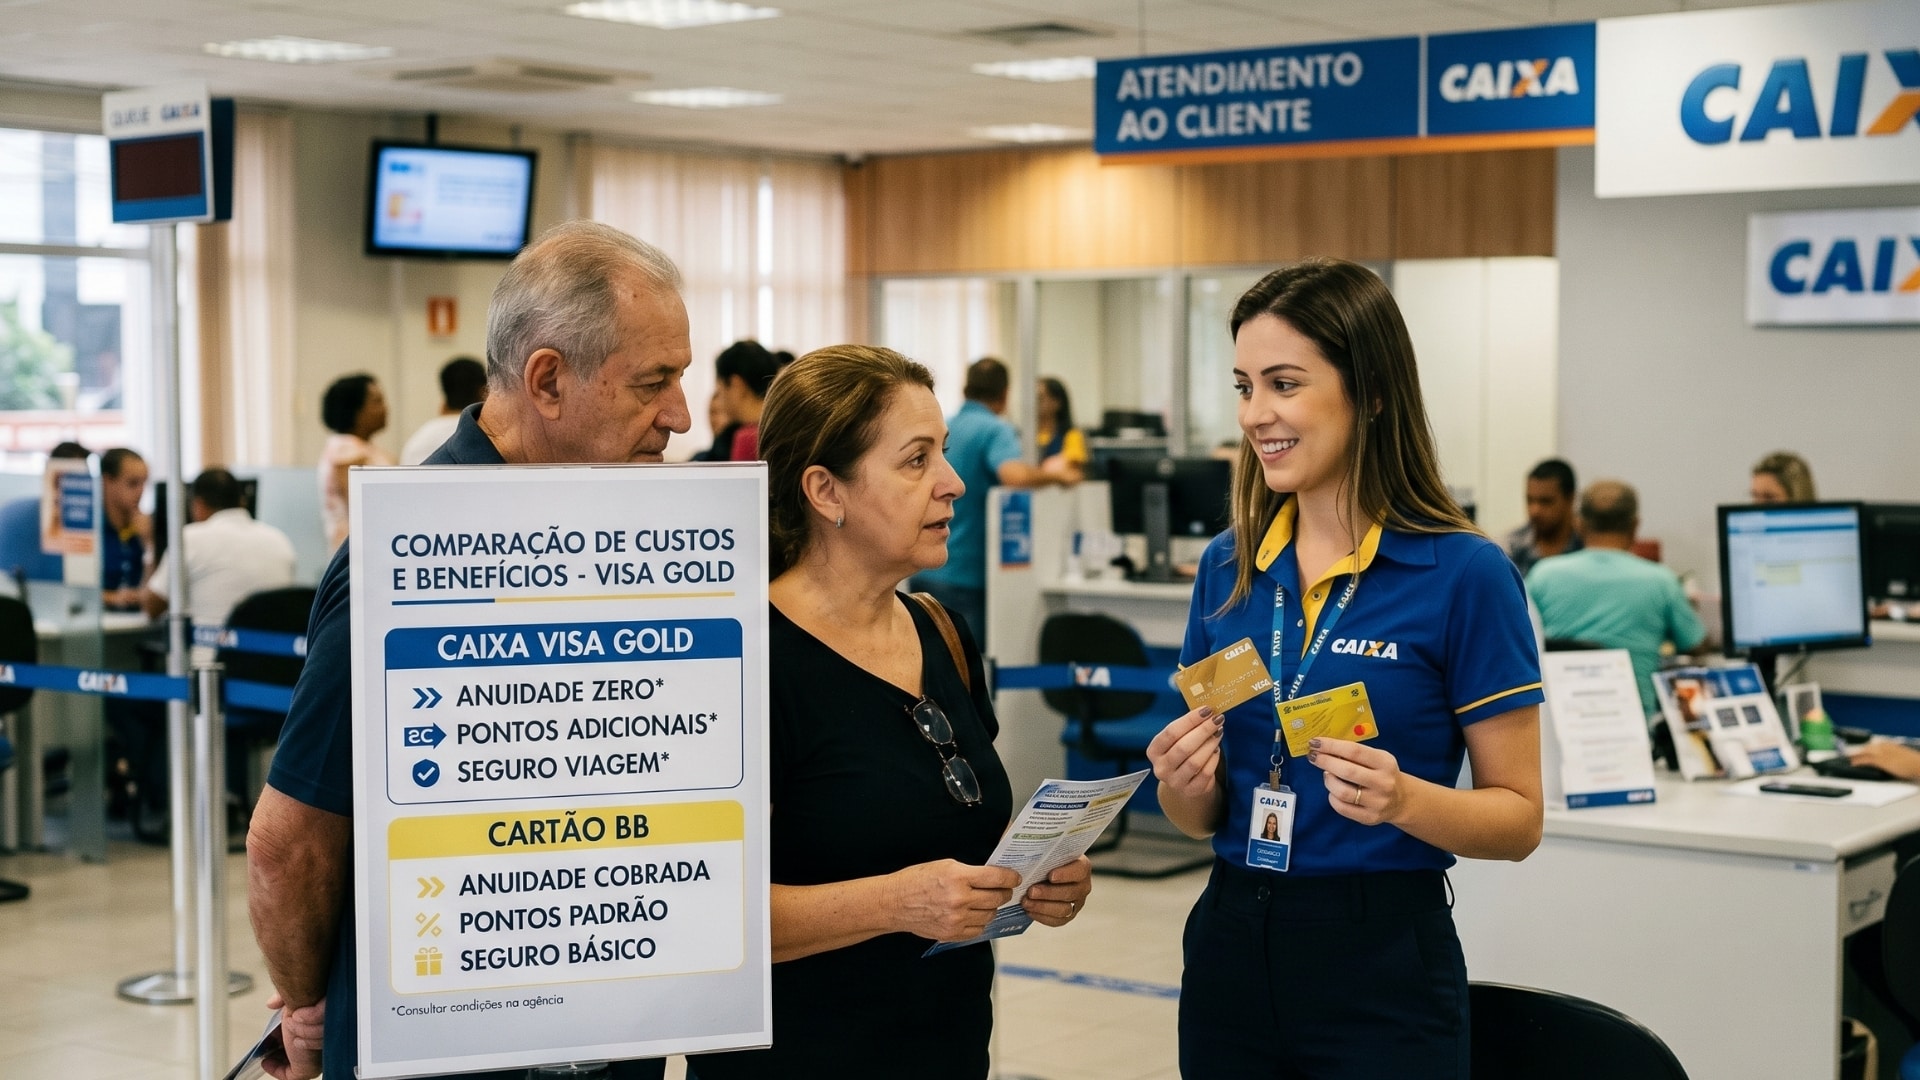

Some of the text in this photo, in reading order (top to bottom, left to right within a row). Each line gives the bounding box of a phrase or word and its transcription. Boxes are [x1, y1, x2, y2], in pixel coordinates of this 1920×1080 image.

[1116, 52, 1363, 101] ATENDIMENTO
[1440, 56, 1580, 102] CAIXA
[1116, 99, 1312, 142] AO CLIENTE
[391, 525, 735, 560] COMPARAÇÃO DE CUSTOS
[393, 567, 406, 591] E
[416, 560, 568, 590] BENEFÍCIOS
[594, 561, 655, 586] VISA
[663, 560, 735, 584] GOLD
[437, 627, 694, 661] CAIXA VISA GOLD
[1331, 638, 1398, 660] CAIXA
[456, 681, 584, 707] ANUIDADE
[457, 719, 559, 745] PONTOS
[457, 756, 558, 783] SEGURO
[488, 811, 650, 848] CARTÃO BB
[458, 859, 711, 897] ANUIDADE COBRADA
[460, 895, 669, 934] PONTOS PADRÃO
[460, 934, 657, 972] SEGURO BÁSICO
[450, 998, 503, 1014] condições
[506, 1000, 519, 1009] na
[522, 995, 564, 1010] agência
